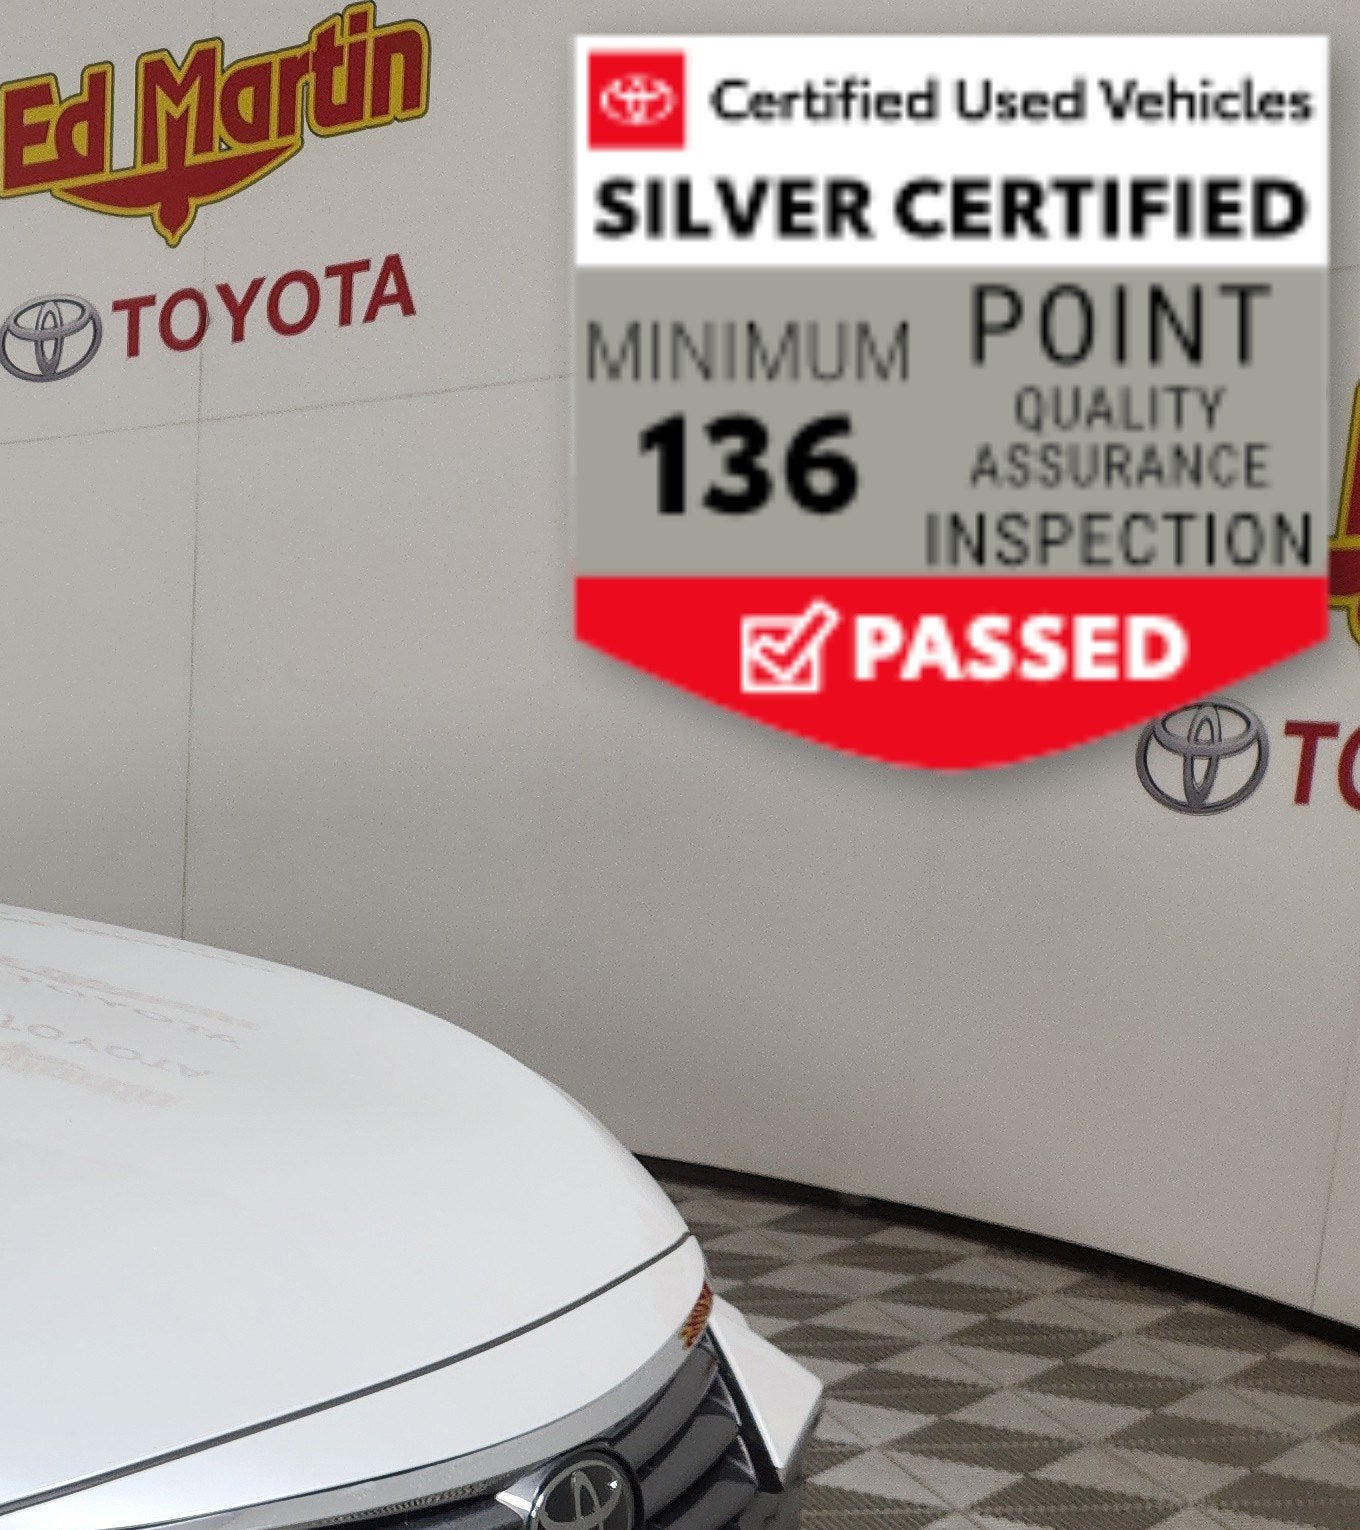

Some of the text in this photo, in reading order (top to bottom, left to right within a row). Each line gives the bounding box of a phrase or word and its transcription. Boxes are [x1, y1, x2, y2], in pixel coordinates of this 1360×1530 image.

[0, 4, 428, 195] Ed Martin
[111, 253, 416, 359] TOYOTA
